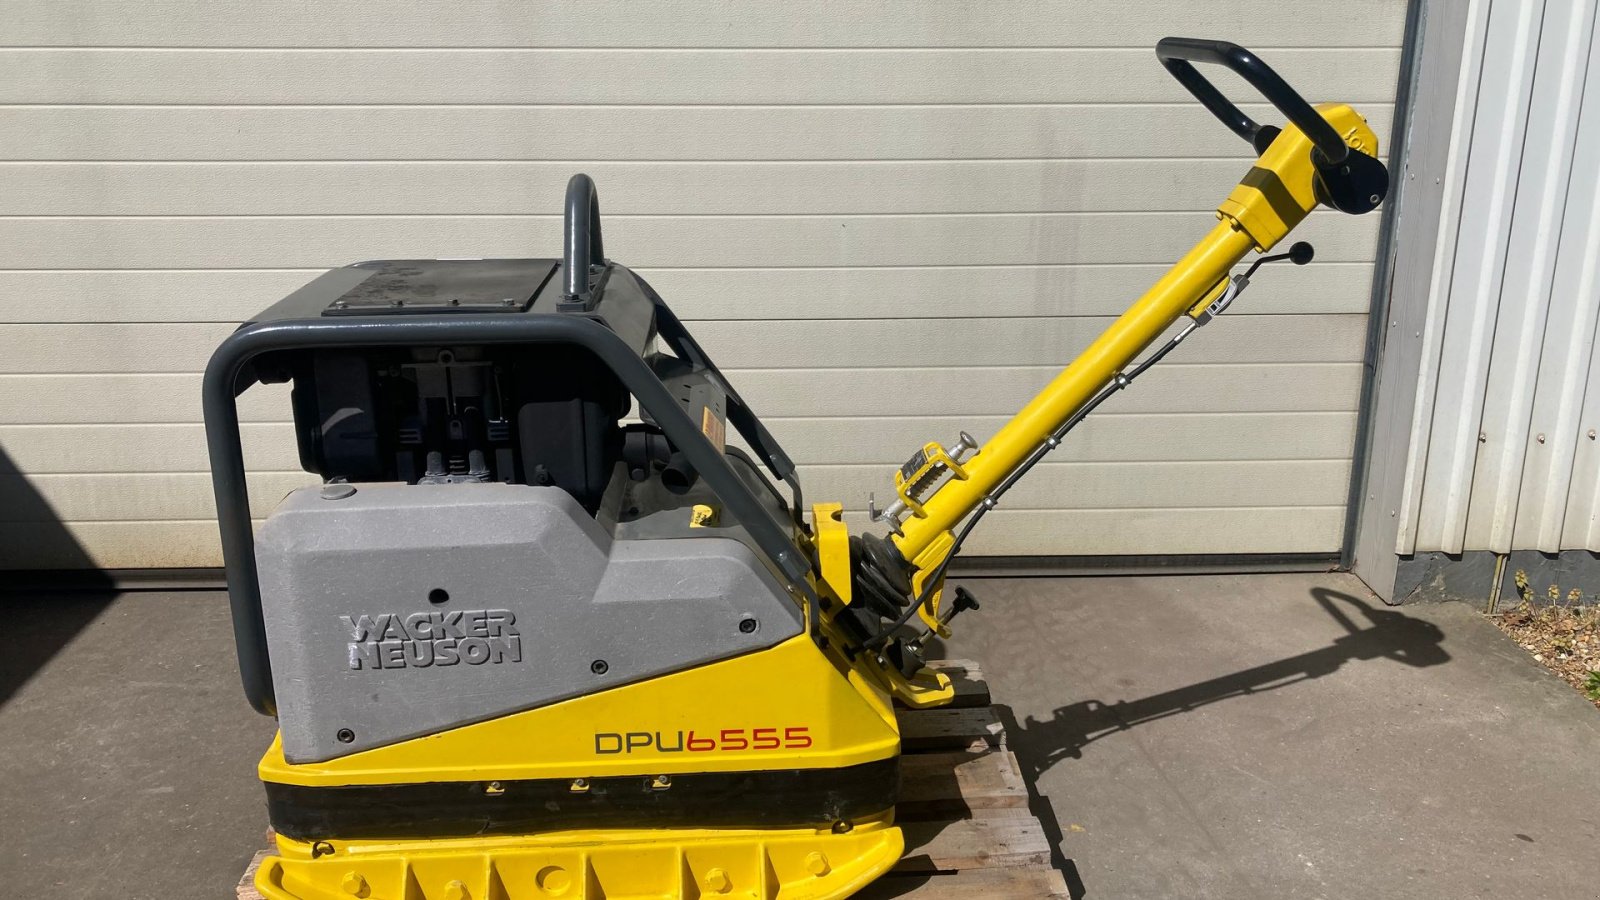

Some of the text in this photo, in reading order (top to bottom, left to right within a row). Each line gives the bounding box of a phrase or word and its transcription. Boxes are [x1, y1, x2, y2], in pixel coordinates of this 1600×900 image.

[339, 608, 521, 643] WACKER
[347, 635, 522, 670] NEUSON
[594, 726, 813, 755] DPU6555
